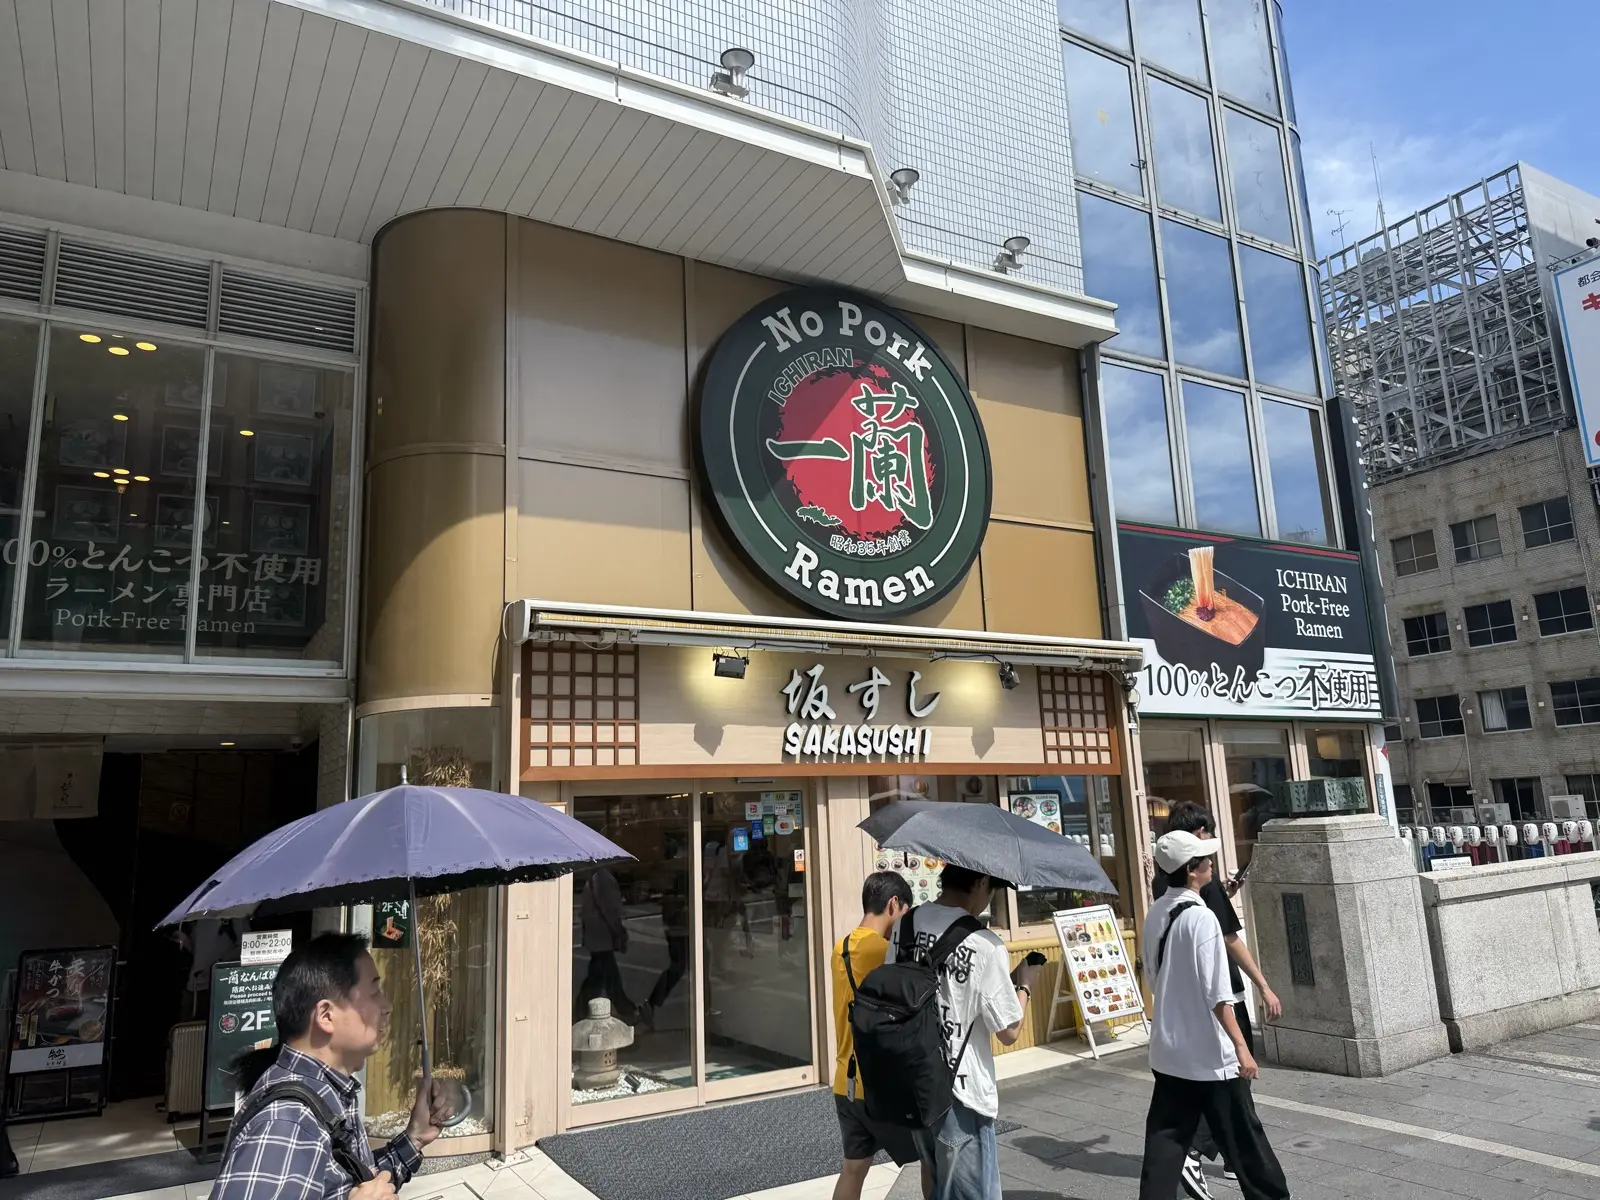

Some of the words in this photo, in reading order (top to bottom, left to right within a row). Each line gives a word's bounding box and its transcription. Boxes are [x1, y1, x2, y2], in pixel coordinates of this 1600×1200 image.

[761, 306, 824, 353] No
[838, 300, 934, 382] Pork
[768, 347, 854, 407] ICHIRAN
[765, 382, 934, 530] 一蘭
[829, 529, 912, 557] 昭和35年創業
[783, 541, 936, 607] Ramen
[1275, 568, 1348, 595] ICHIRAN
[56, 608, 171, 631] Pork-Free
[181, 614, 257, 634] amen
[1281, 593, 1350, 618] Pork-Free
[1294, 617, 1344, 640] Ramen
[1143, 661, 1372, 711] 100%とんこつ不使用
[783, 722, 932, 756] SAKASUSHI
[240, 1009, 272, 1032] 2F
